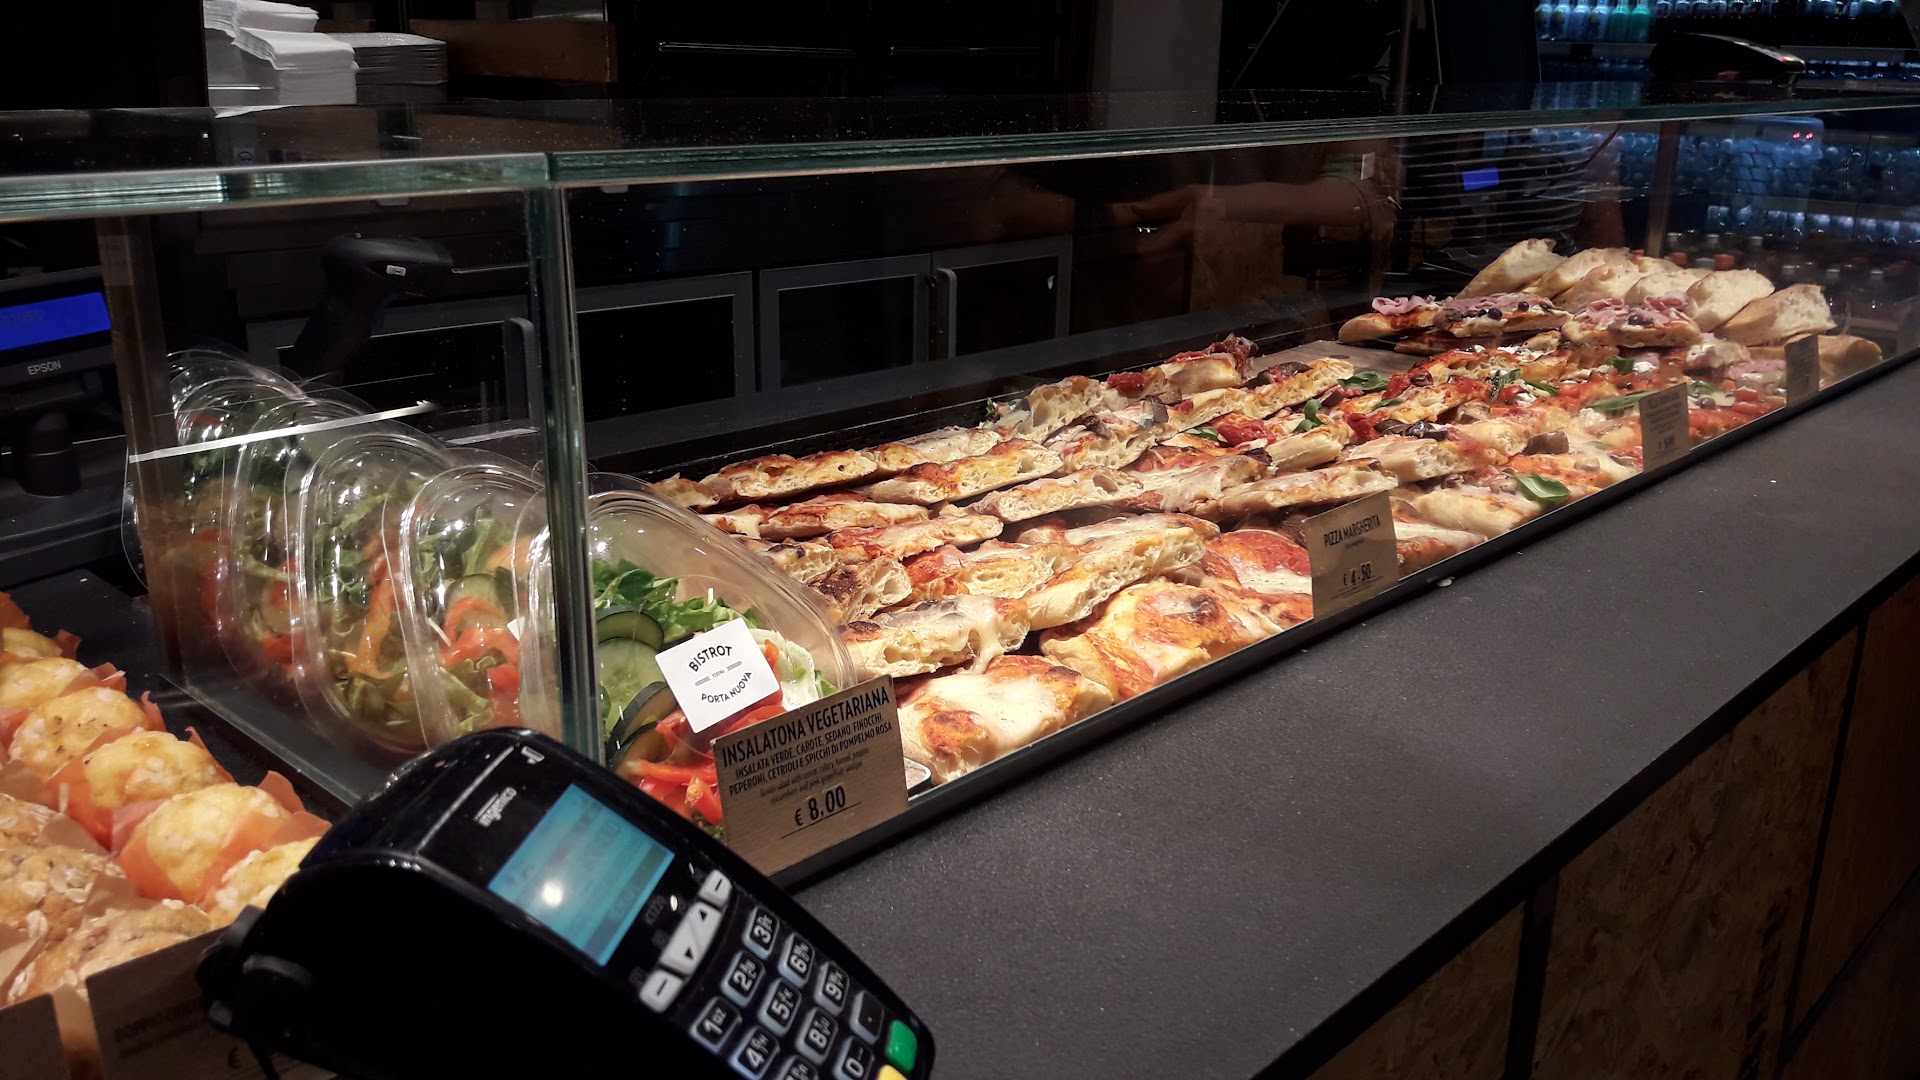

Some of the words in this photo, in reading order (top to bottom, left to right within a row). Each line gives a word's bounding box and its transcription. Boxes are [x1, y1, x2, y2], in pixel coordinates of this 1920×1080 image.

[28, 360, 62, 375] EPSON
[1323, 529, 1344, 547] PIZZA
[1343, 515, 1381, 541] MARGHERITA
[688, 645, 733, 672] BISTROT
[701, 692, 730, 704] PORTA
[730, 671, 752, 698] NUOVA
[722, 720, 806, 768] INSALATONA
[806, 686, 890, 734] VEGETARIANA
[767, 758, 799, 780] CETRIOLI
[799, 756, 804, 768] E
[805, 746, 831, 765] SPICCHI
[831, 743, 839, 755] DI
[839, 728, 875, 751] POMPELMO
[875, 721, 893, 735] ROSA
[736, 757, 770, 779] INSALATA
[794, 807, 803, 826] €
[808, 785, 846, 820] 8,00
[752, 926, 771, 944] 3
[789, 954, 807, 974] 6
[733, 972, 753, 992] 2
[825, 982, 843, 1001] 9
[771, 999, 791, 1020] 5
[702, 1019, 723, 1036] 1
[808, 1027, 828, 1049] 8
[745, 1047, 766, 1069] 4
[845, 1057, 864, 1079] 0
